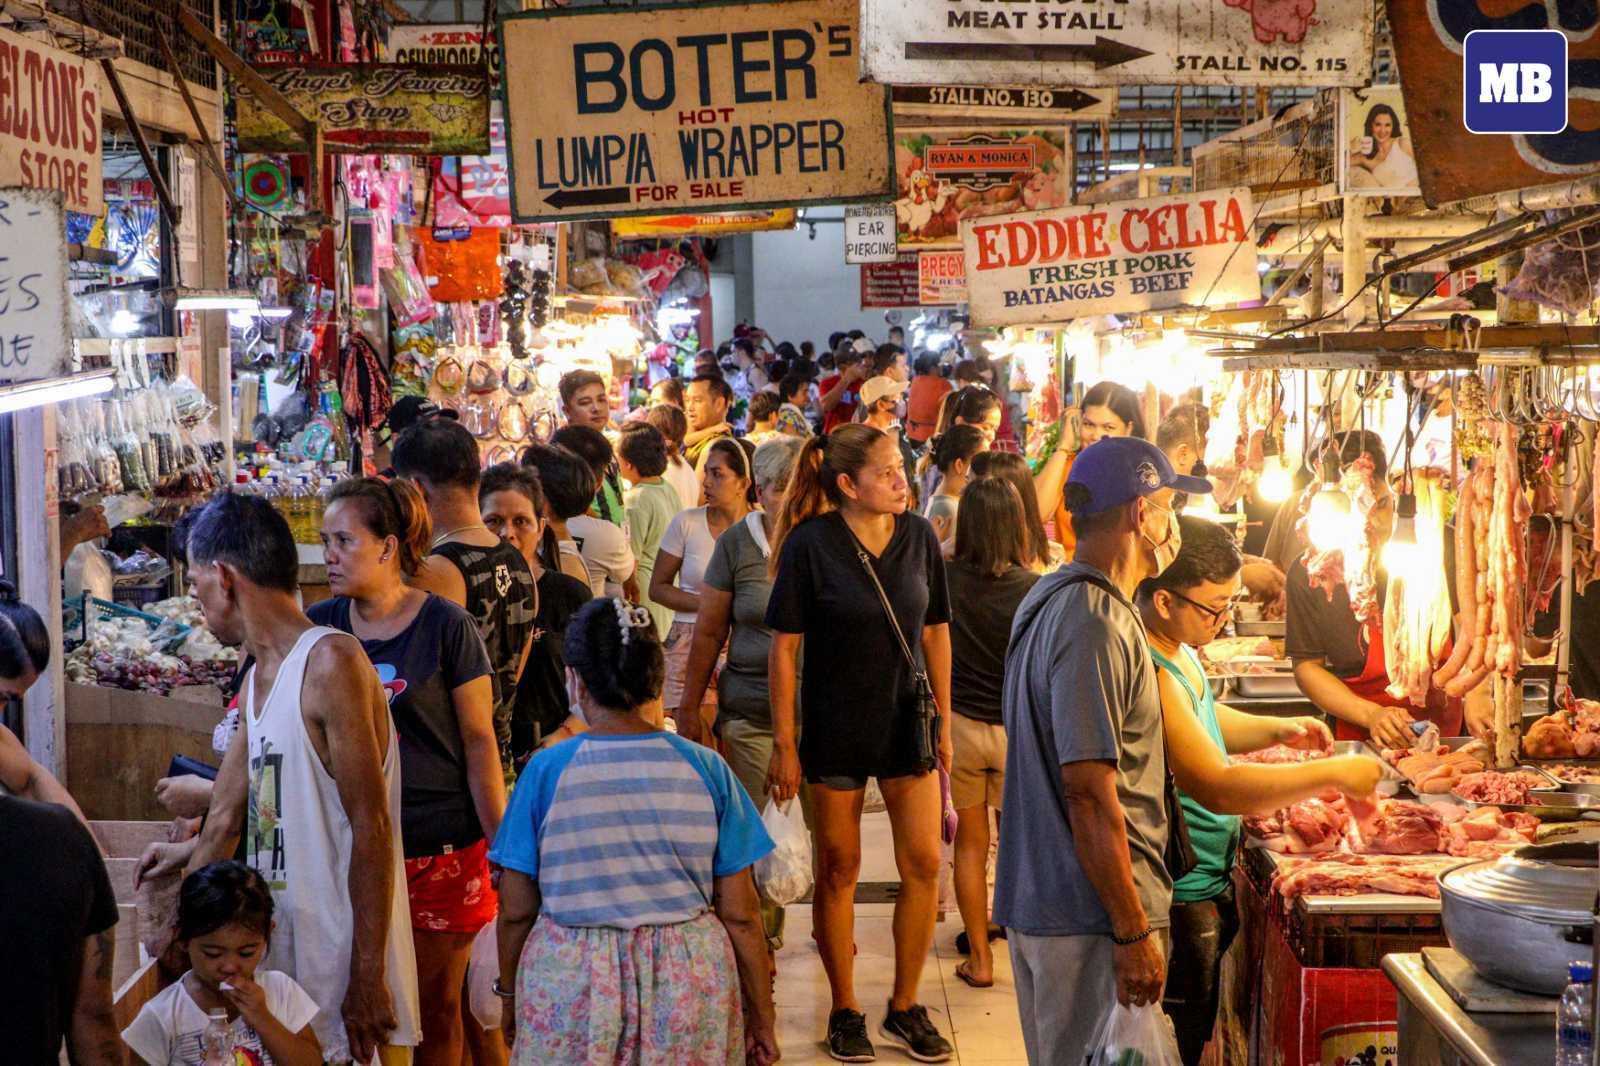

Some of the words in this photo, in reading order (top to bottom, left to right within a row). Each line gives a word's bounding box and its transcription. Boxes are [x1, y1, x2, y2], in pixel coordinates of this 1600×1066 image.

[947, 10, 1028, 28] MEAT
[1037, 11, 1123, 30] STALL
[1175, 54, 1252, 71] STALL
[1259, 56, 1307, 71] NO.
[1315, 57, 1348, 71] 115
[928, 86, 977, 106] STALL
[983, 89, 1015, 107] NO.
[1022, 89, 1055, 109] 130
[320, 98, 412, 127] Shop
[678, 107, 735, 125] HOT
[535, 132, 657, 190] LUMPIA
[677, 118, 846, 181] WRAPPER
[931, 151, 964, 164] RYAN
[967, 153, 977, 163] &
[980, 151, 1029, 163] MONICA
[20, 148, 89, 207] STORE
[635, 185, 678, 202] FOR
[690, 181, 744, 198] SALE
[696, 215, 721, 225] THIS
[858, 221, 885, 236] EAR
[972, 212, 1112, 271] EDDIE
[1119, 196, 1250, 254] CELIA
[846, 241, 896, 257] PIERCING
[1028, 258, 1119, 286] FRESH
[1123, 252, 1197, 276] PORK
[1002, 279, 1117, 307] BATANGAS
[1130, 272, 1194, 295] BEEF
